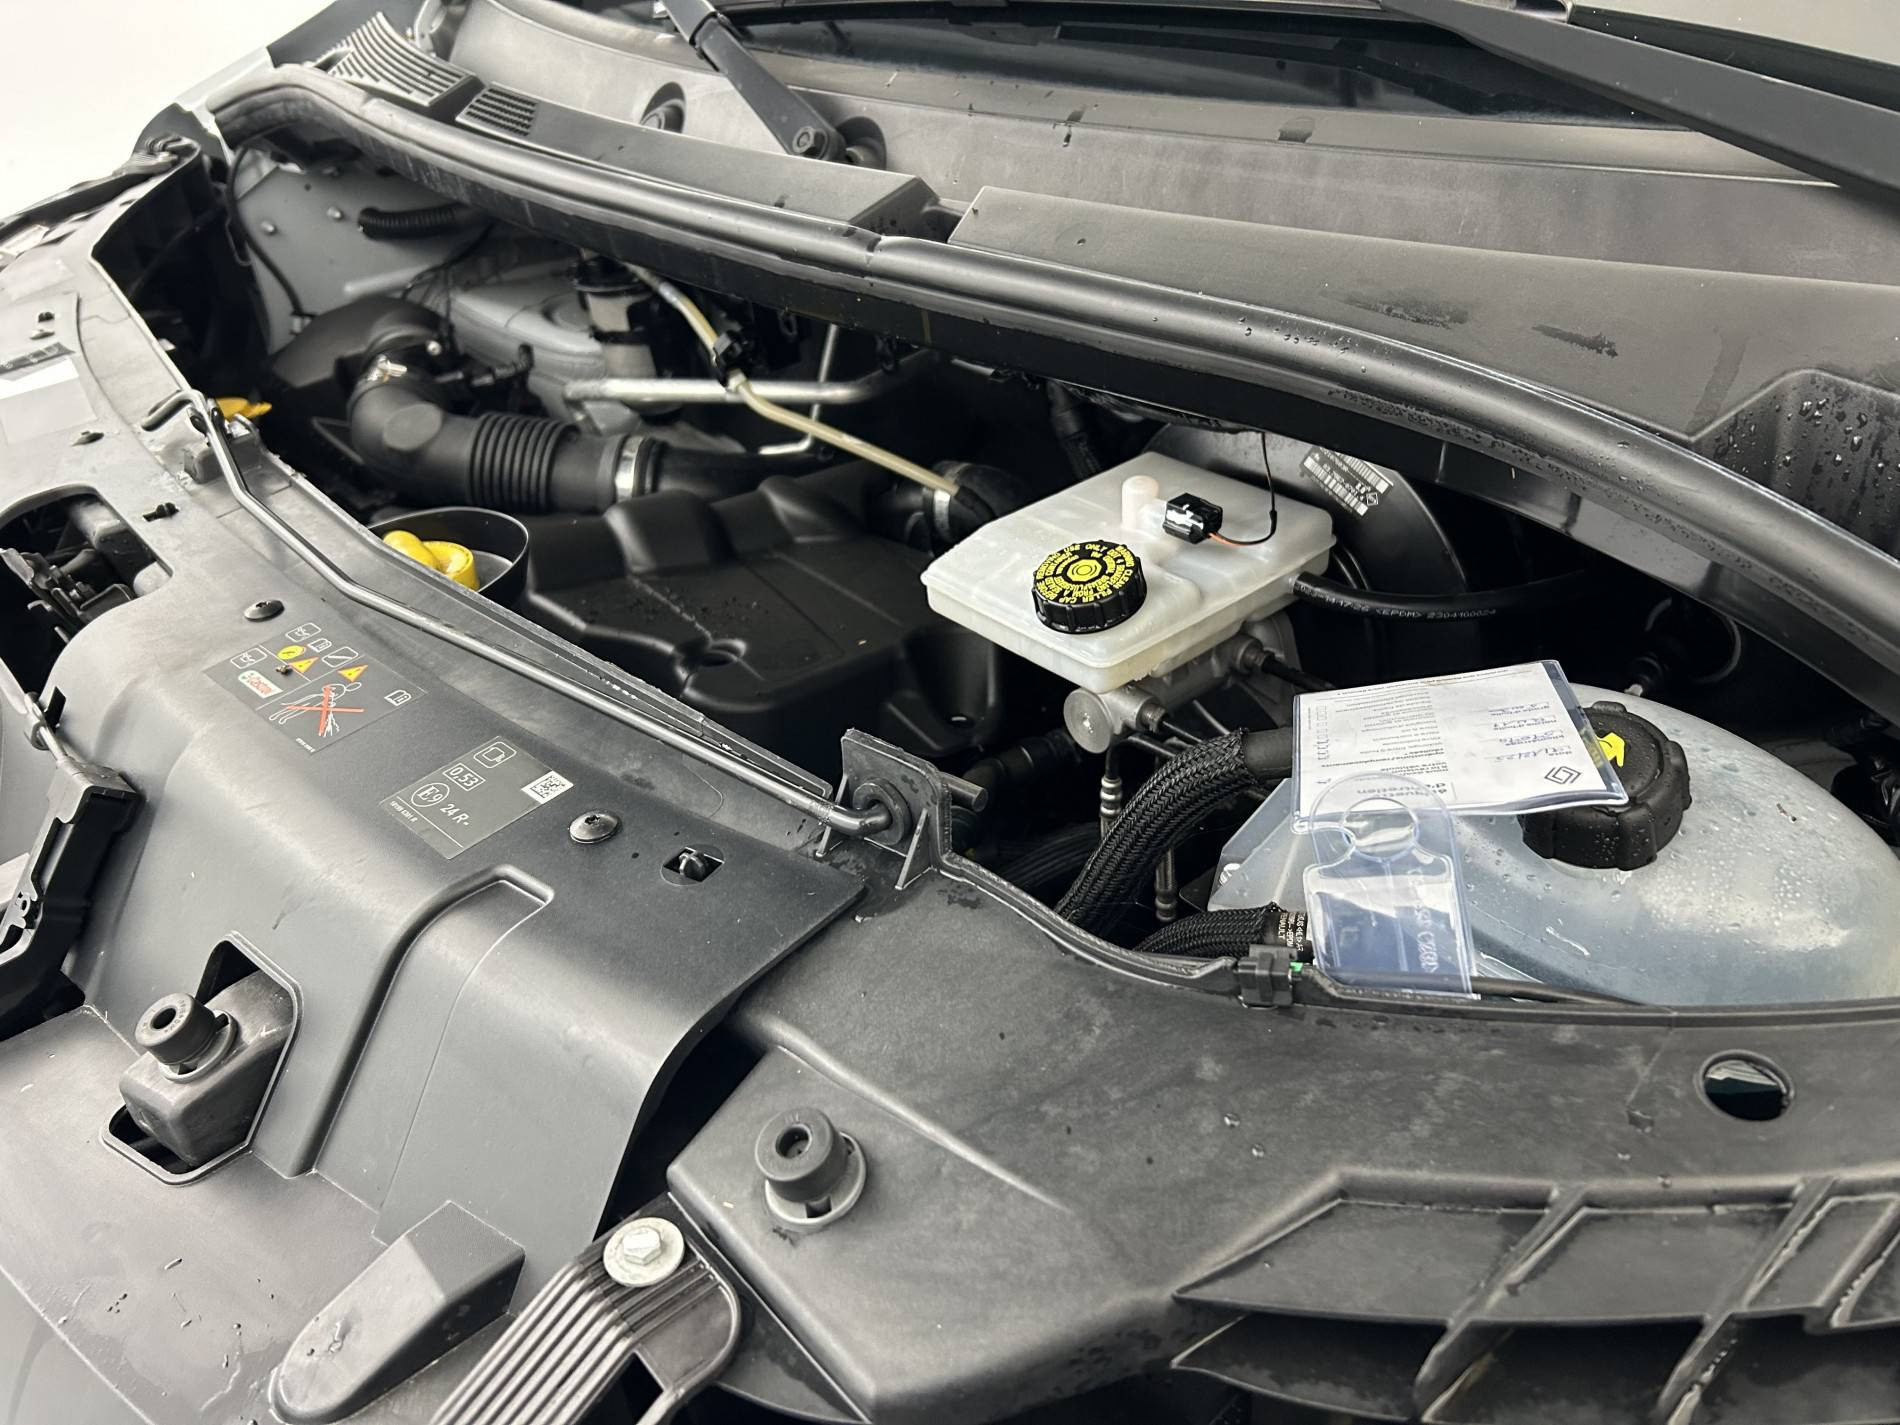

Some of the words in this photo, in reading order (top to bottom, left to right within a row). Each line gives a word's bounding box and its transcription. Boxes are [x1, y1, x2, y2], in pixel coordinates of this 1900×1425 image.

[1063, 544, 1081, 552] USE
[1085, 543, 1107, 552] ONLY
[1113, 569, 1133, 590] CLEAN
[1058, 596, 1077, 604] CAP
[1082, 588, 1113, 603] FILLER
[448, 766, 477, 788] 0,53
[439, 803, 456, 816] 24
